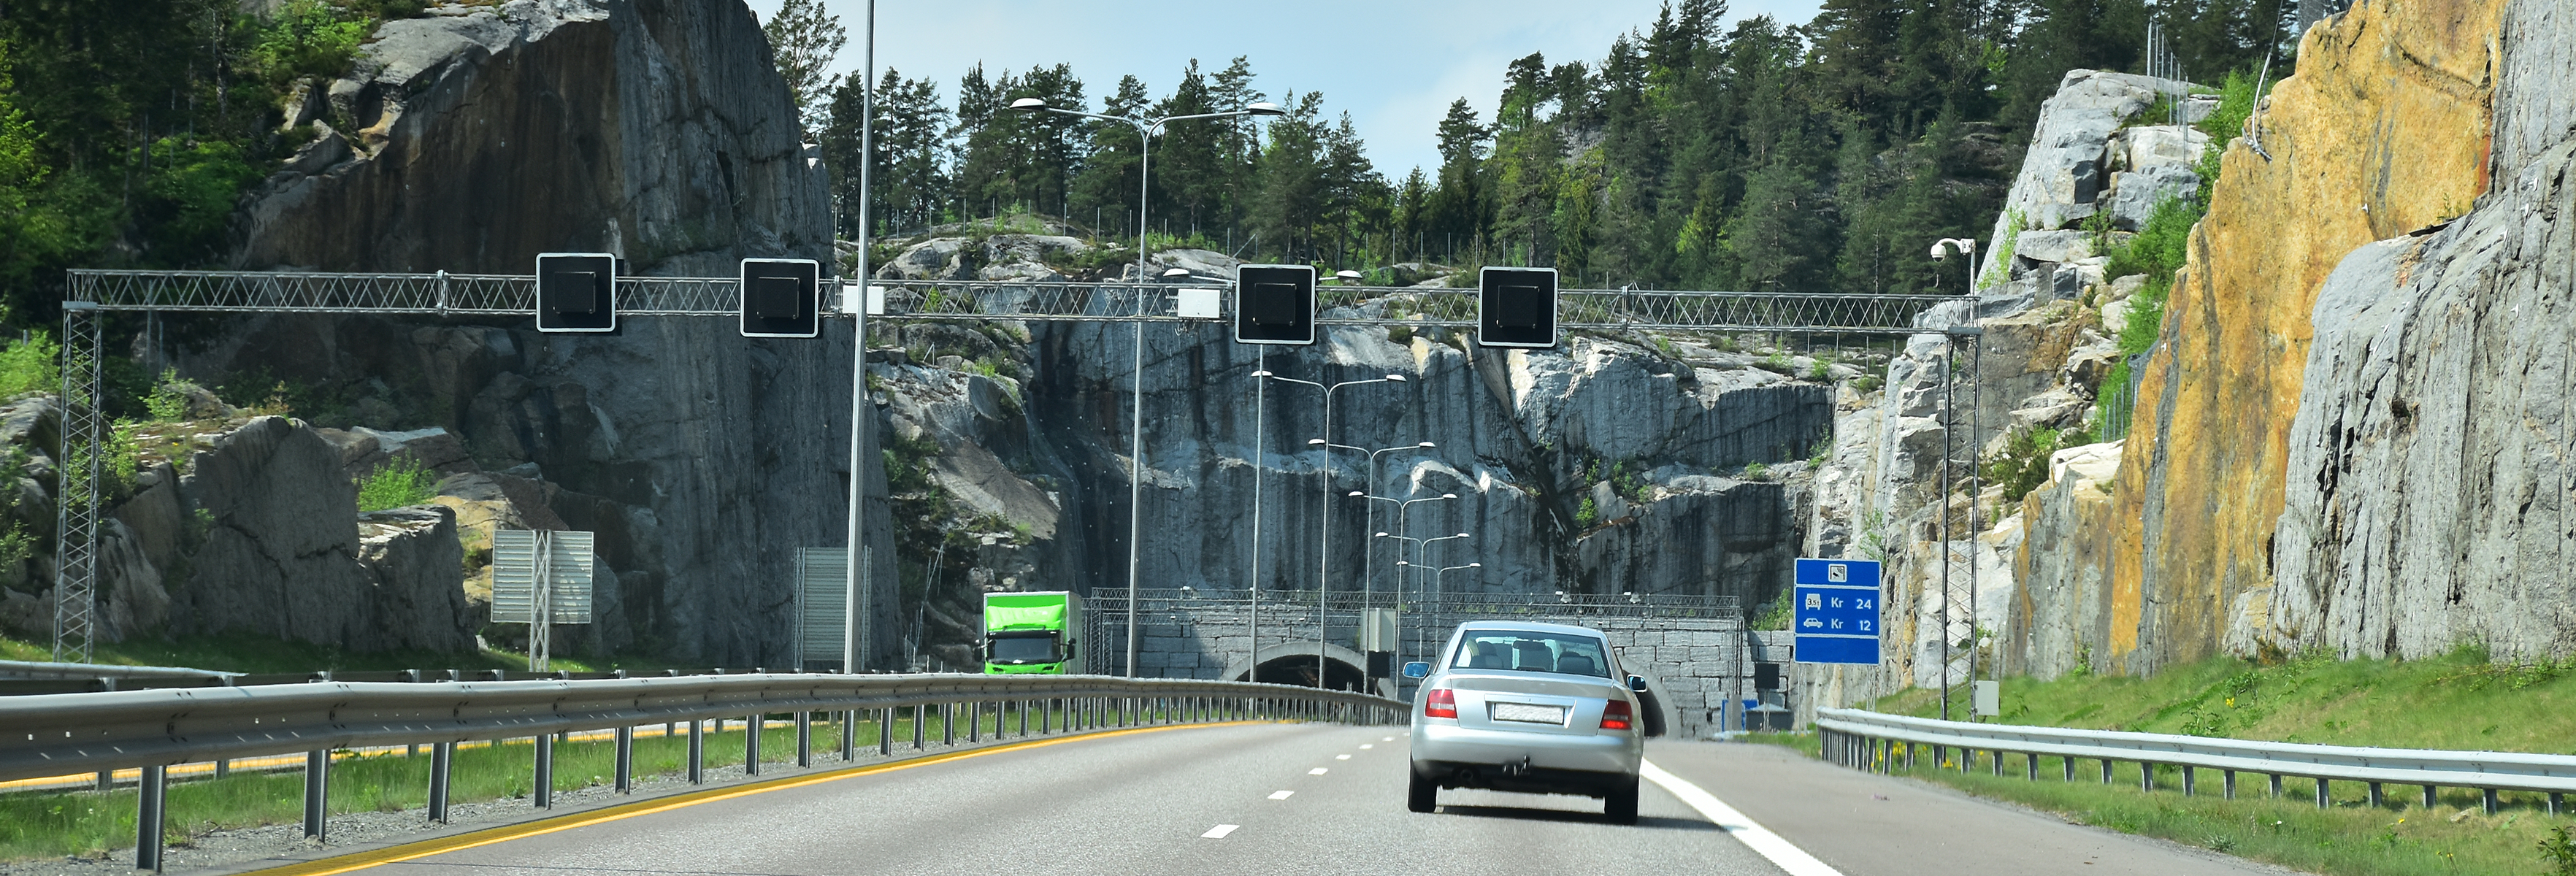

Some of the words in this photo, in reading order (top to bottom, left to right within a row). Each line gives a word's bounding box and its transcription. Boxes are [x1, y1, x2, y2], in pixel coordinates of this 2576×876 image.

[1831, 597, 1844, 608] Kr
[1856, 599, 1872, 610] 24
[1831, 618, 1844, 629] Kr
[1859, 620, 1871, 631] 12
